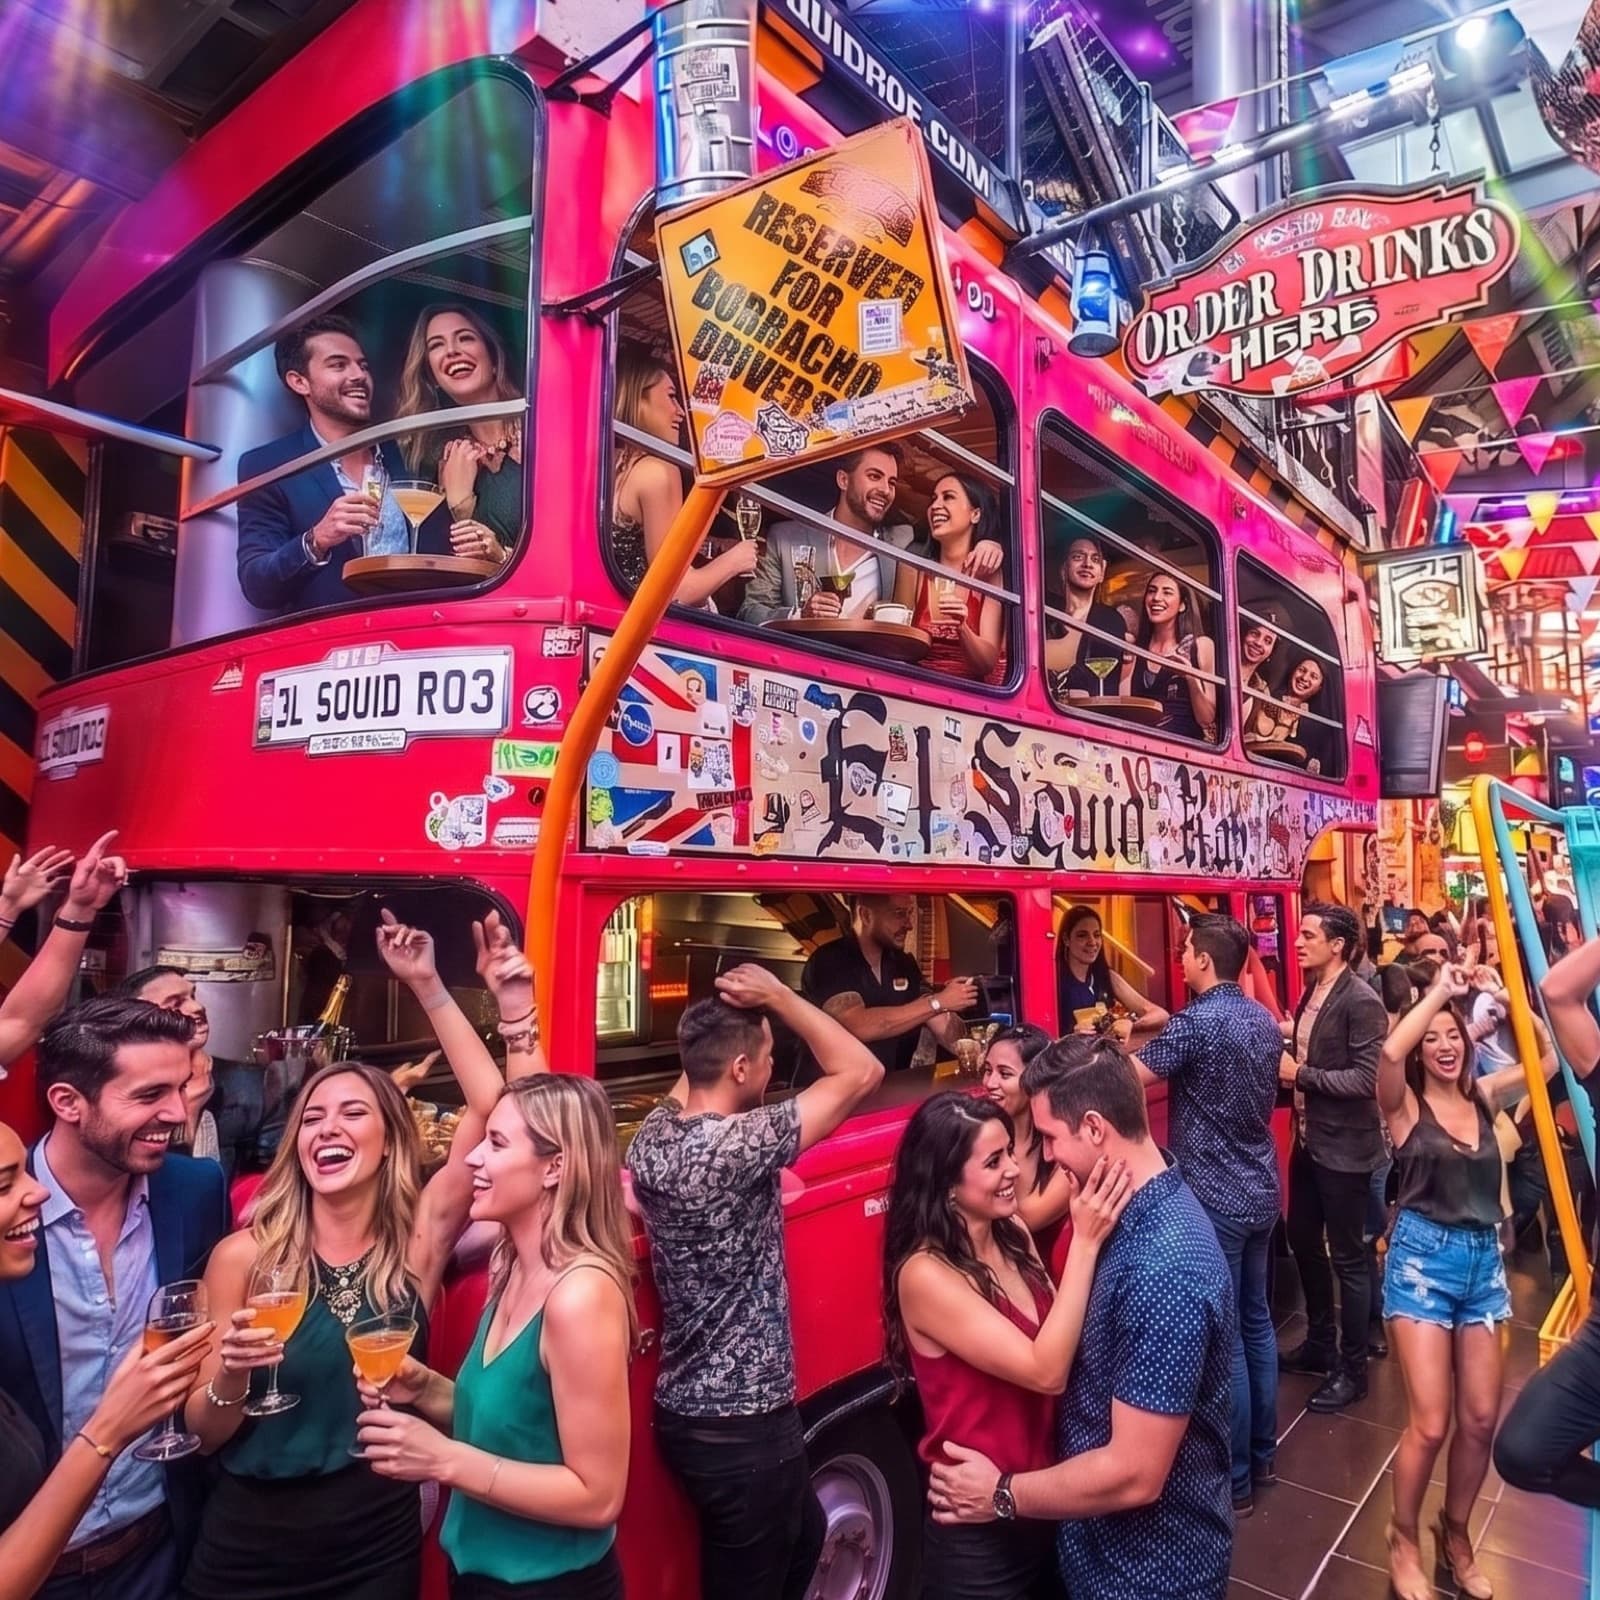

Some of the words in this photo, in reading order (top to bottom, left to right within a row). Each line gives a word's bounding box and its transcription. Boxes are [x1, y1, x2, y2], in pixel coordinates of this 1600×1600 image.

[769, 260, 844, 328] FOR
[1136, 272, 1282, 365] ORDER
[1298, 208, 1496, 308] DRINKS
[1230, 297, 1379, 383] HERE
